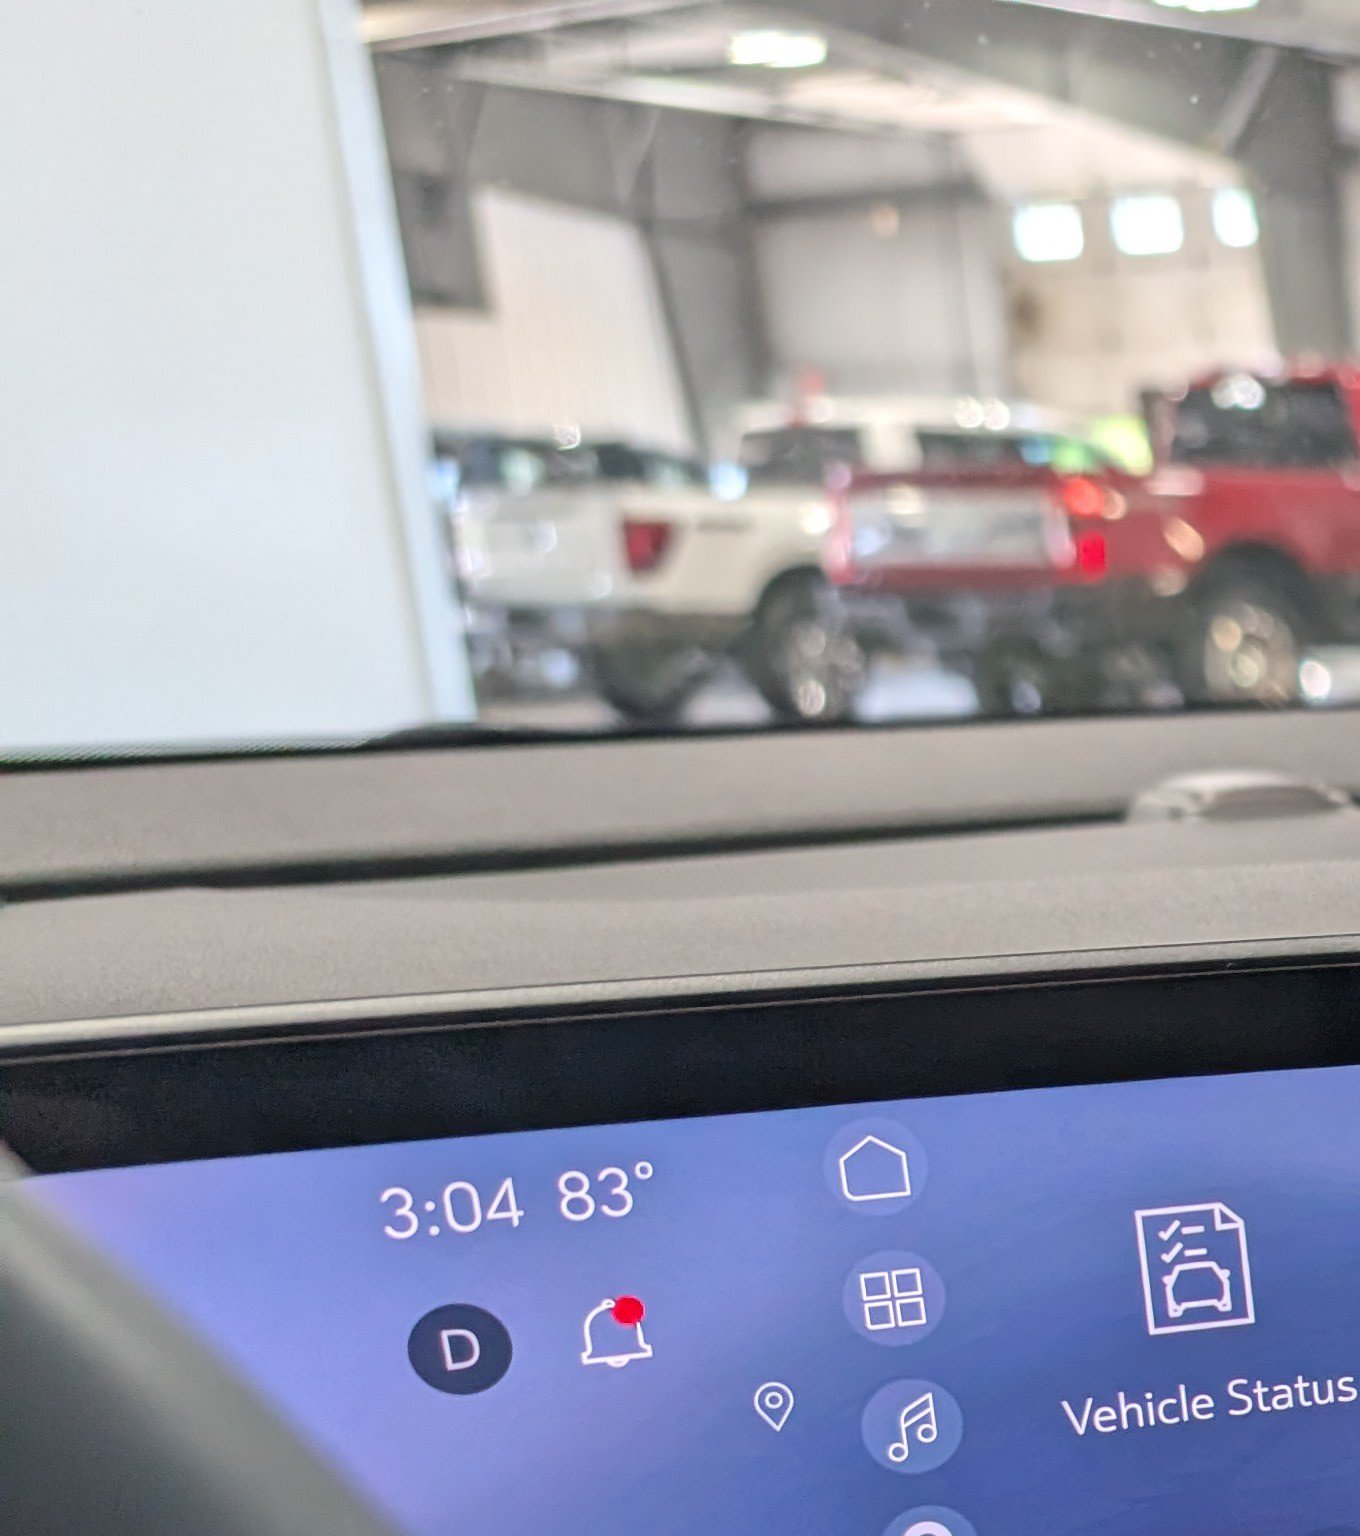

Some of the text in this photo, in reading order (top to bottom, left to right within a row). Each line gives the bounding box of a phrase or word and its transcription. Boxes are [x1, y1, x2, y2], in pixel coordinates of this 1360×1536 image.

[380, 1160, 653, 1240] 3:04 83°
[440, 1329, 480, 1371] D
[1061, 1372, 1358, 1435] Vehicle Status
